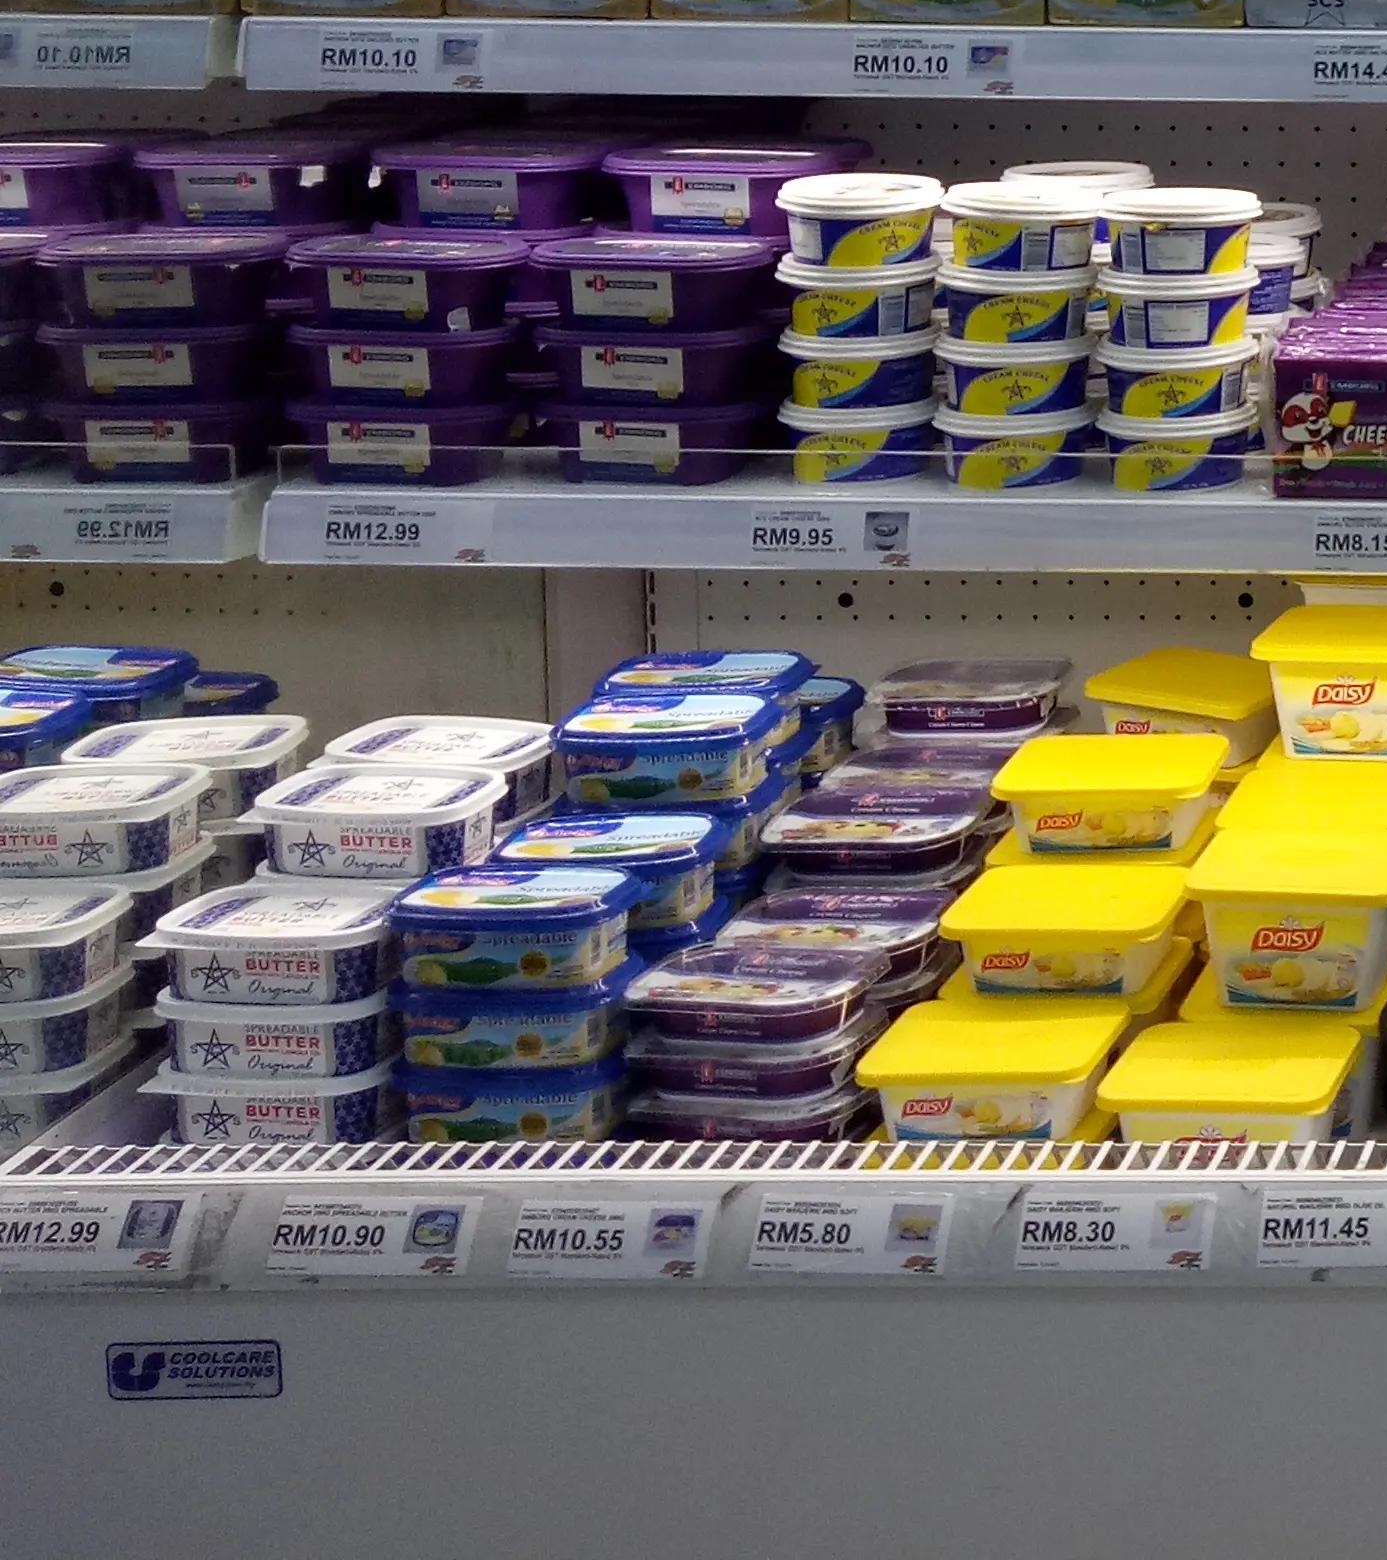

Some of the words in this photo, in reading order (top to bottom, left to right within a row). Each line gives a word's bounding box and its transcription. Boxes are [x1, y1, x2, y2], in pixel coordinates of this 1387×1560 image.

[321, 48, 417, 68] RM10.10
[853, 53, 948, 75] RM10.10
[325, 521, 421, 541] RM12.99
[752, 527, 833, 547] RM9.95
[487, 930, 578, 947] Spreadable
[1258, 924, 1320, 951] Daisy
[245, 958, 320, 974] BUTTER
[247, 978, 314, 1000] Original
[0, 1222, 100, 1242] RM12.99
[273, 1225, 385, 1246] RM10.90
[757, 1222, 851, 1244] RM5.80
[1021, 1220, 1116, 1242] RM8.30
[1262, 1218, 1369, 1239] RM11.45
[513, 1229, 624, 1251] RM10.55
[170, 1351, 273, 1366] COOLCARE
[167, 1365, 274, 1379] SOLUTIONS
